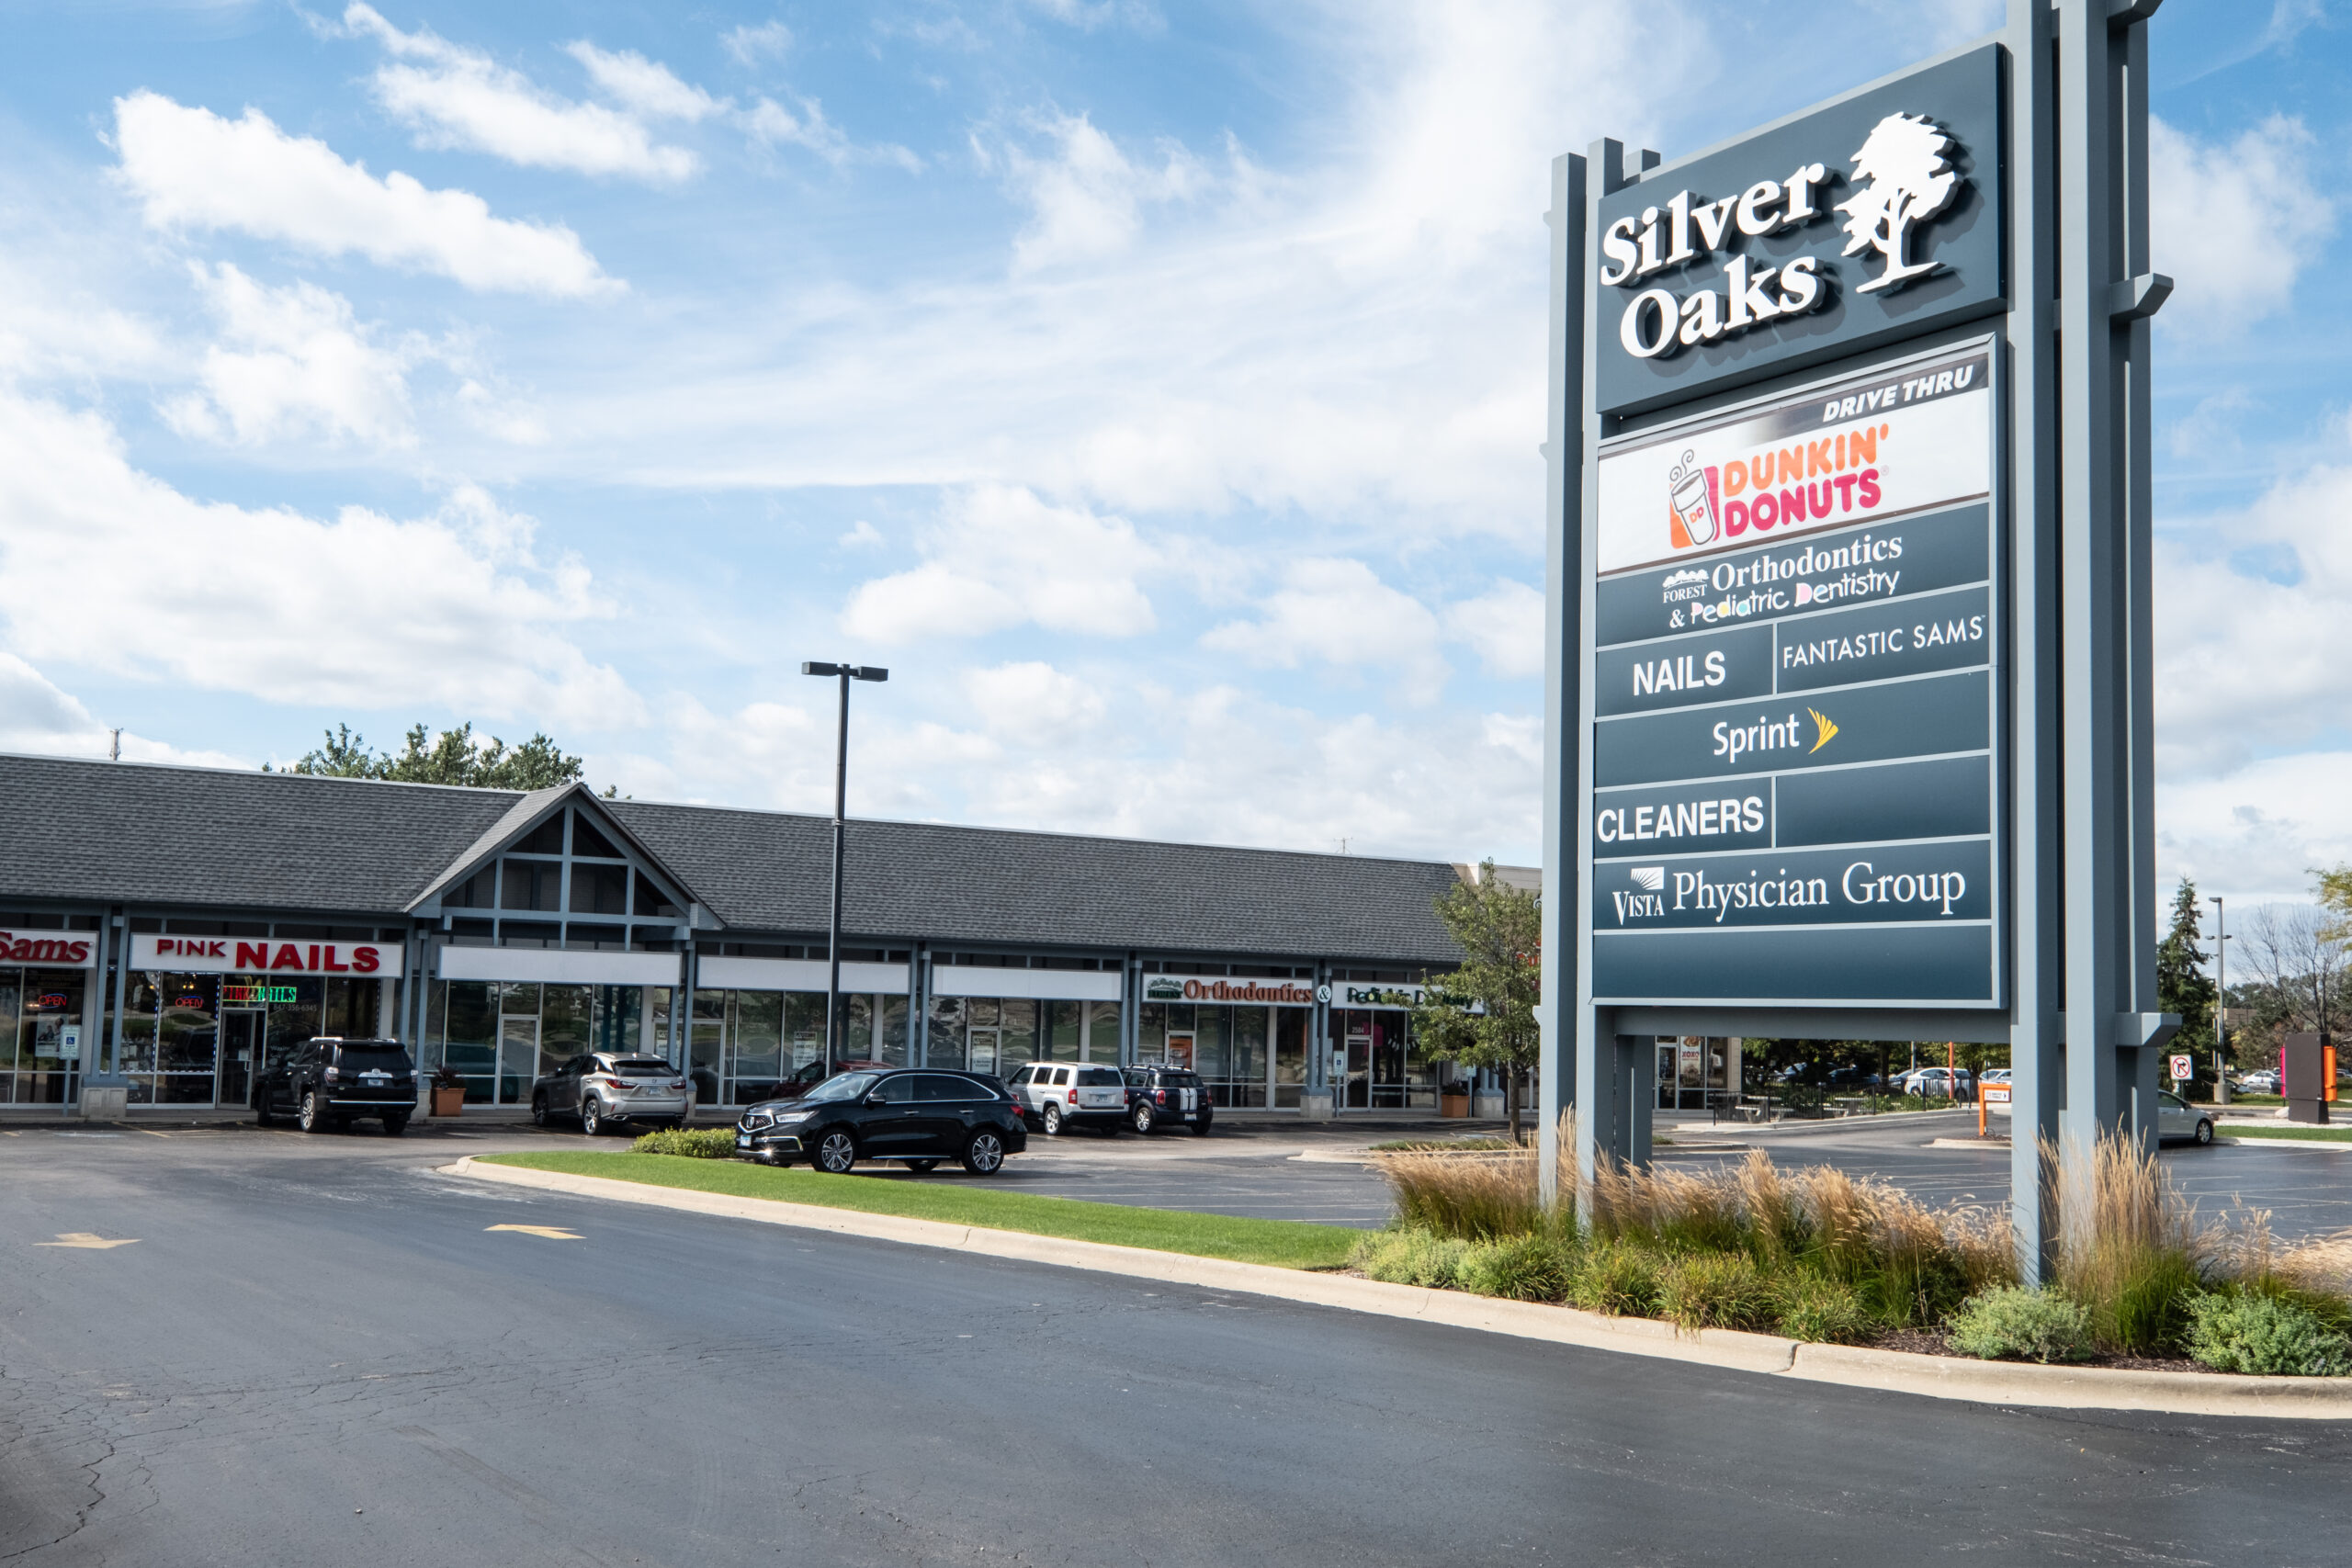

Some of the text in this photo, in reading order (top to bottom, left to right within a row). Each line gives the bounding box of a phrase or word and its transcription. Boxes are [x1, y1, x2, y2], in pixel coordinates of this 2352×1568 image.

[1600, 163, 1826, 286] Silver
[1620, 255, 1817, 358] Oaks
[1823, 365, 1973, 423] DRIVE THRU
[1724, 423, 1889, 497] DUNKIN'
[1724, 468, 1882, 537] DONUTS
[1662, 535, 1903, 604] FOREST Orthodontics
[1669, 569, 1900, 629] & Pediatric Dentistry
[1783, 616, 1983, 668] FANTASTIC SAMS
[1634, 651, 1726, 696] NAILS
[1713, 714, 1800, 763] Sprint
[1597, 796, 1764, 842] CLEANERS
[1673, 868, 1829, 922] Physician
[1842, 862, 1966, 915] Group
[156, 939, 380, 972] PINK NAILS
[38, 995, 67, 1007] OPEN
[175, 998, 203, 1009] OPEN
[1183, 979, 1313, 1003] Orthodontics
